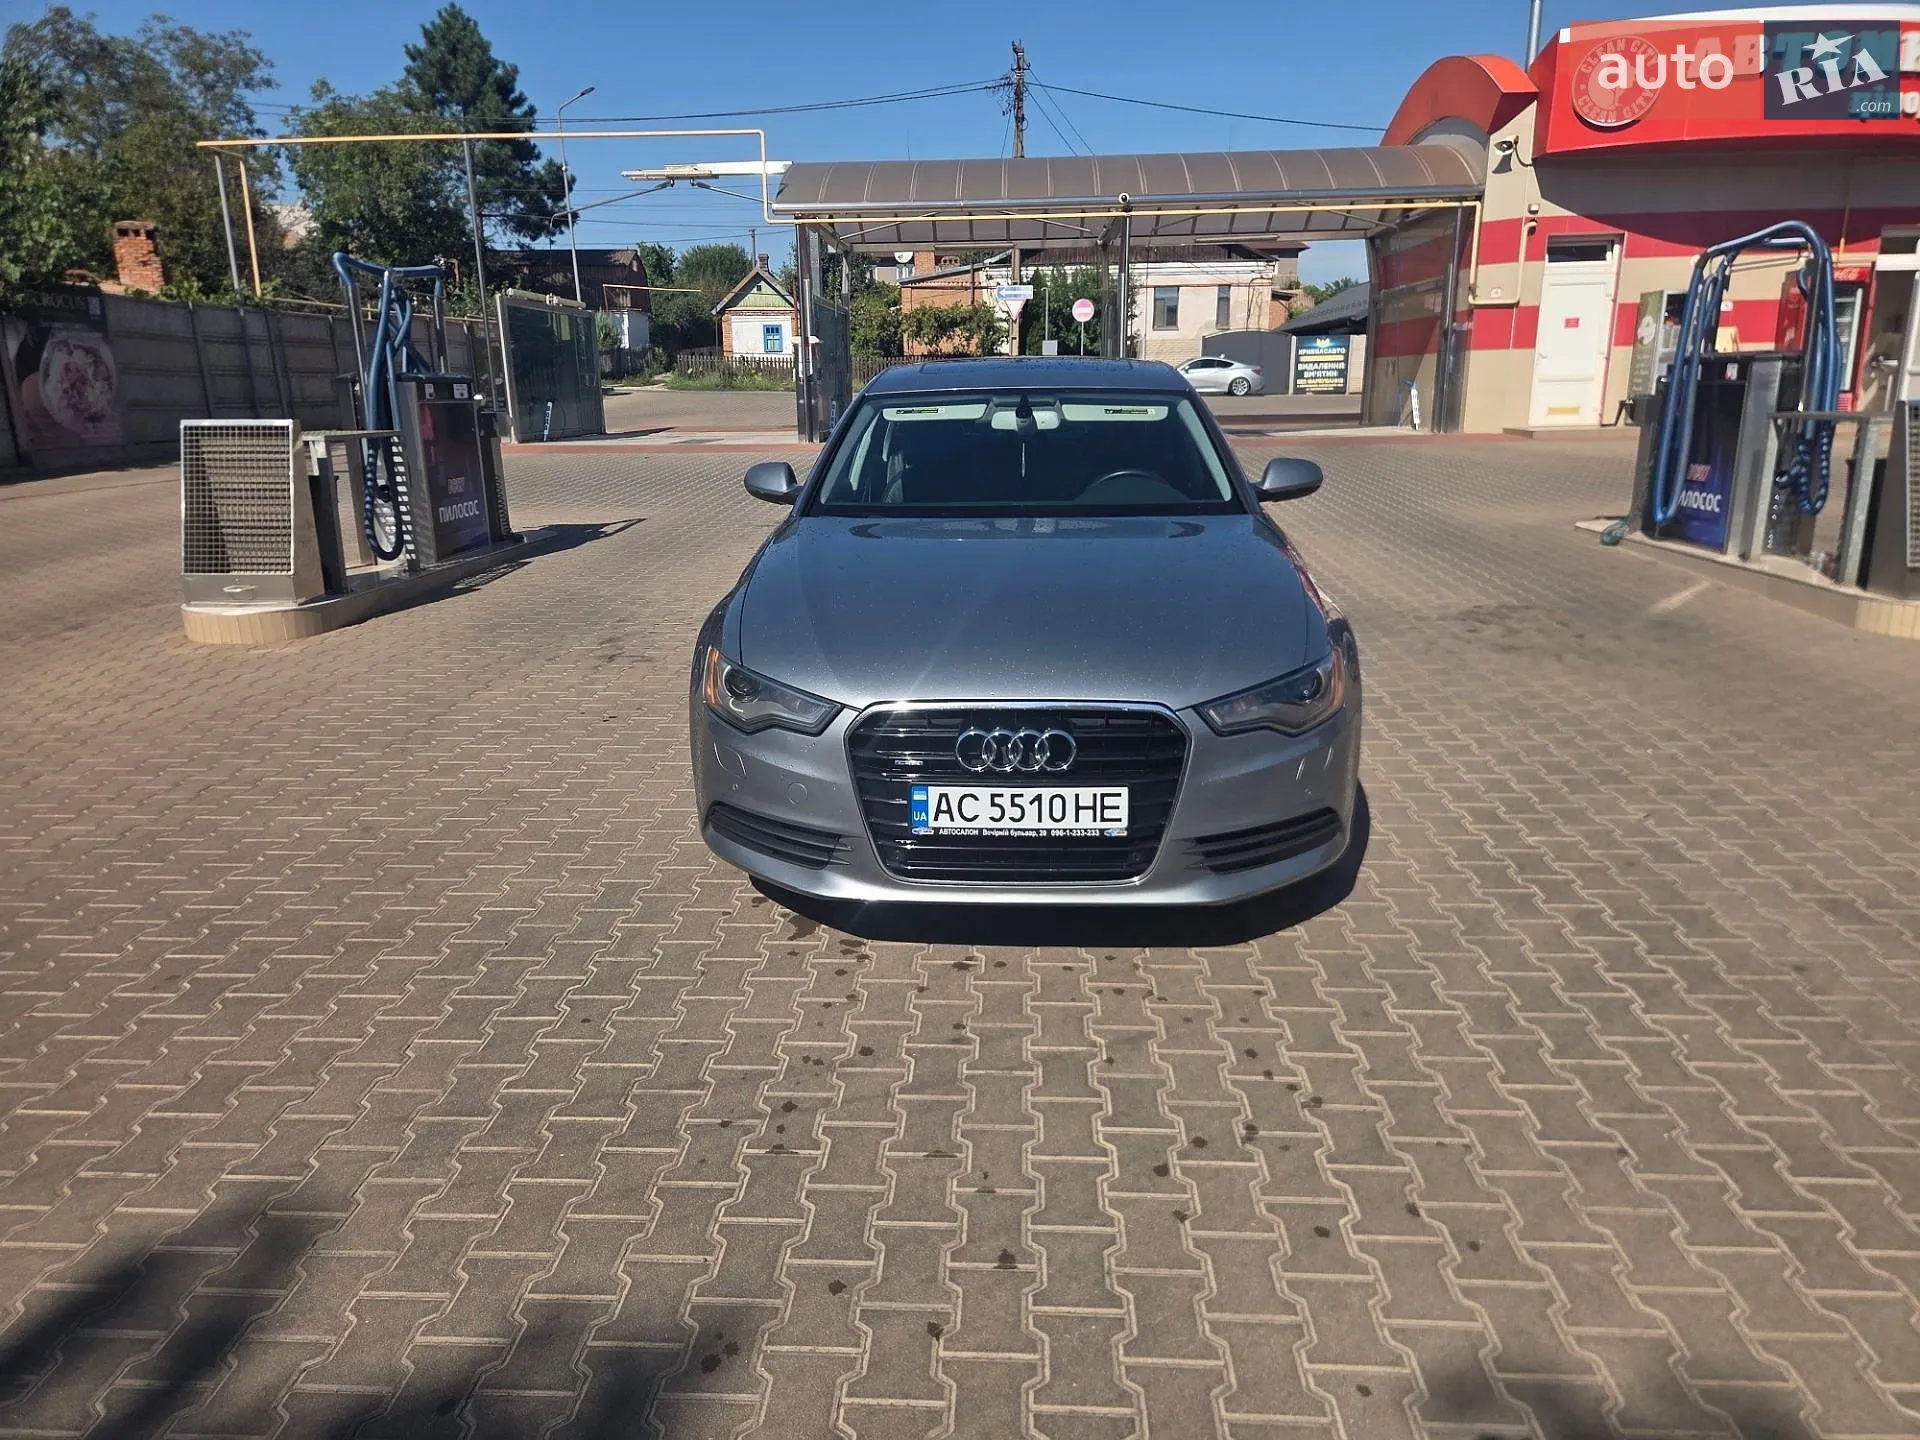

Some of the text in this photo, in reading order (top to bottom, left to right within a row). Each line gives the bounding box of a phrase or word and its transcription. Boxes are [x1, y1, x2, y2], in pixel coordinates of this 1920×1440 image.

[1580, 38, 1626, 74] CLEAN
[1577, 89, 1655, 123] CLEAN CITY
[438, 499, 480, 523] ПИЛОСОС
[913, 811, 928, 822] UA
[933, 792, 1123, 823] AC 5510 HE
[938, 828, 979, 836] АВТОСАЛОН
